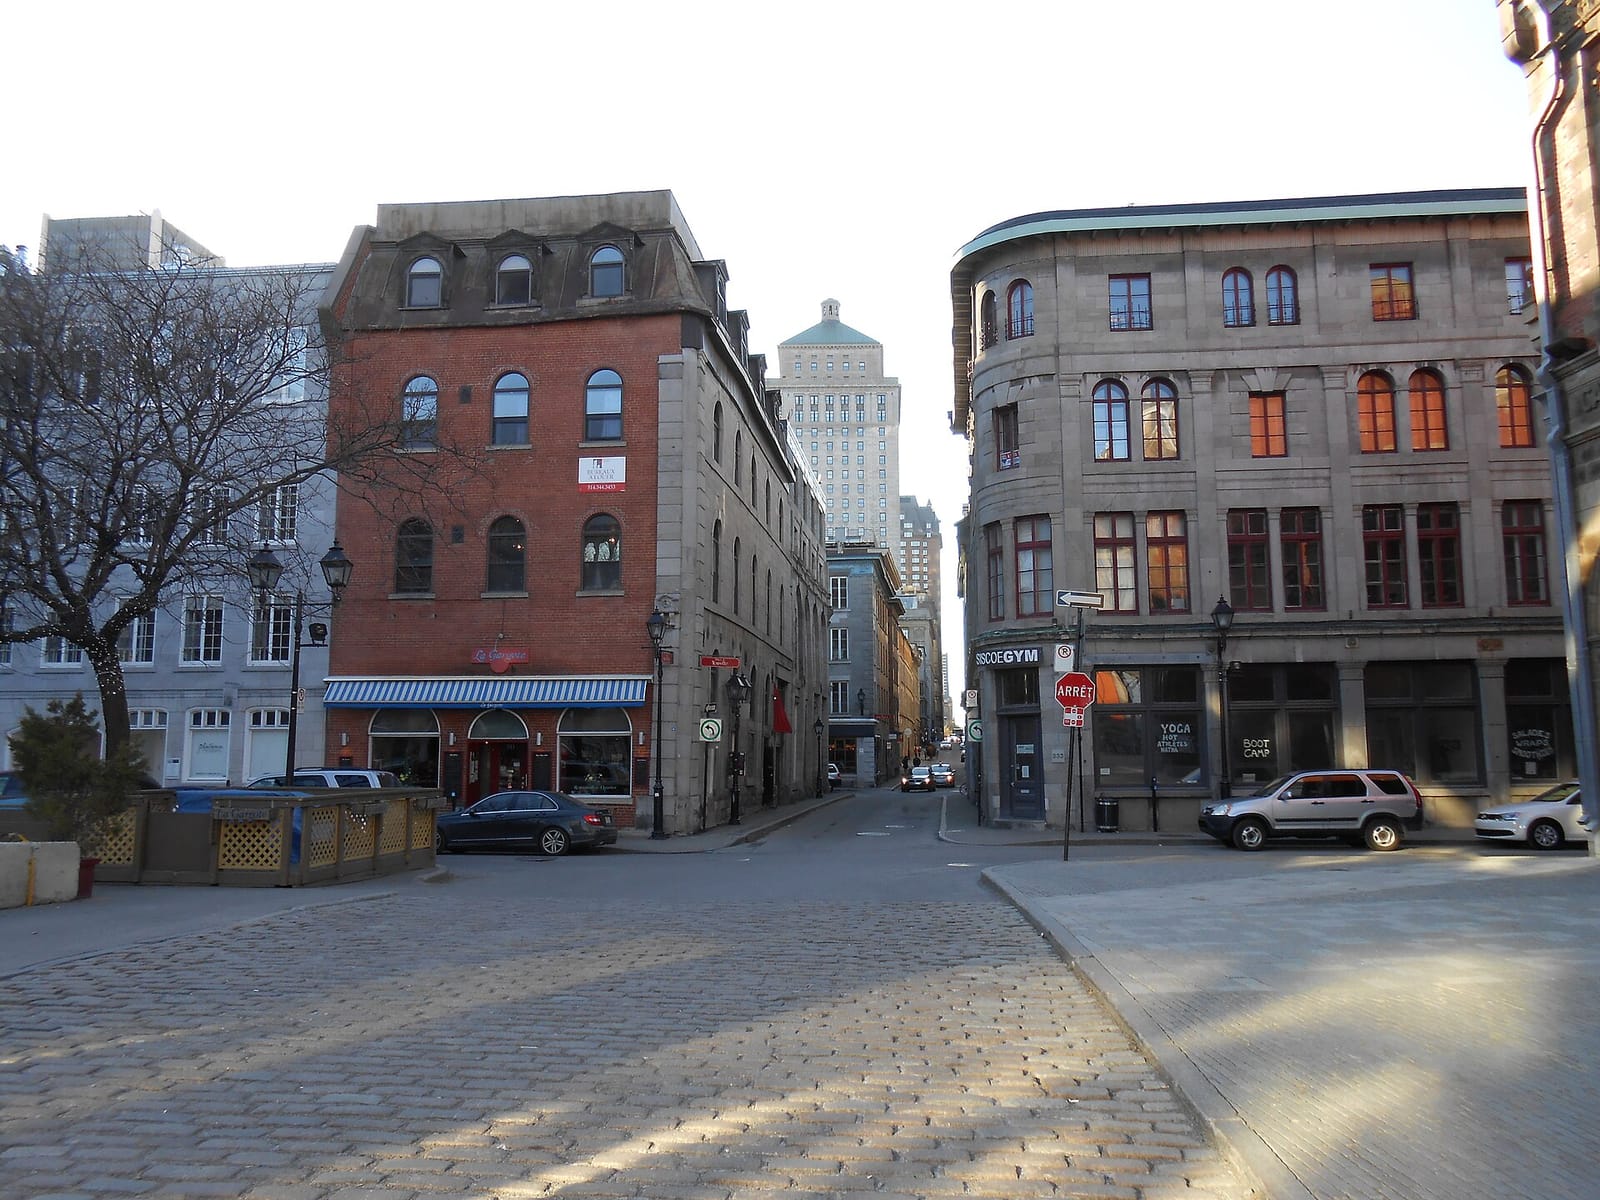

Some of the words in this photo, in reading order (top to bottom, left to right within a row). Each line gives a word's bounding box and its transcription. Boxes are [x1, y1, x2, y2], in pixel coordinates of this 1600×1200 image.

[1057, 685, 1094, 699] ARRÊT
[1160, 723, 1190, 734] YOGA
[1243, 738, 1270, 748] BOOT
[1243, 749, 1270, 758] CAMP
